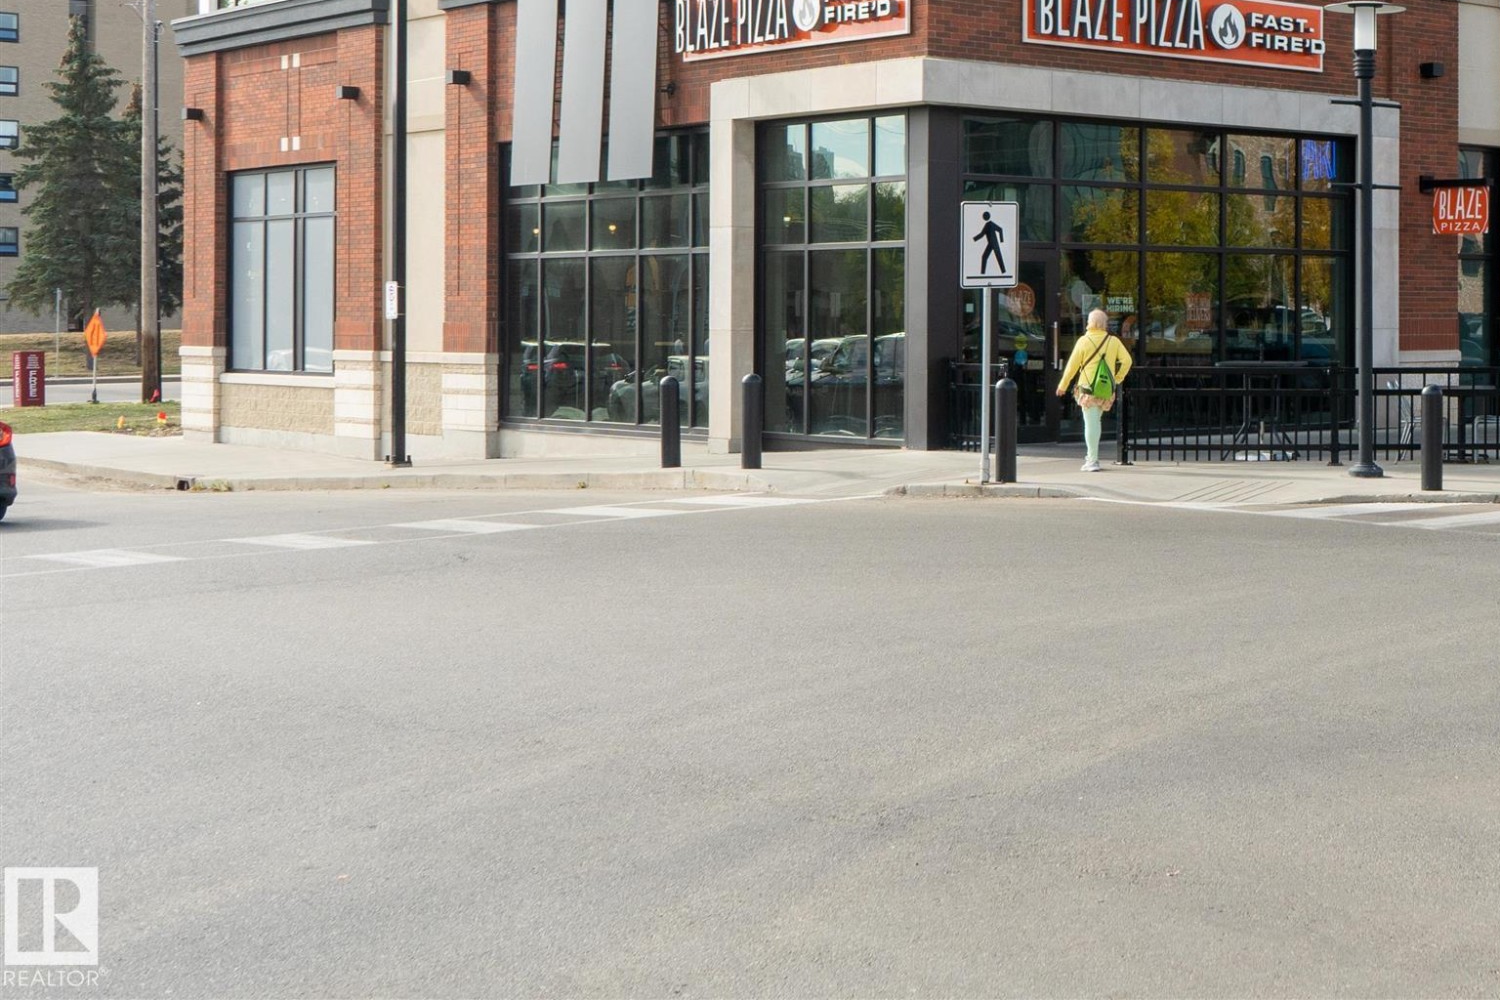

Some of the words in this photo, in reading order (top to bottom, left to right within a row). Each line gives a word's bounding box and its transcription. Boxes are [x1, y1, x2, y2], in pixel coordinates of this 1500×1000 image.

[824, 0, 892, 25] FIRE'D
[1252, 12, 1315, 34] FAST.
[1252, 32, 1327, 56] FIRE'D
[1438, 187, 1483, 221] BLAZE
[1440, 221, 1482, 232] PIZZA
[1106, 304, 1135, 313] HIRING
